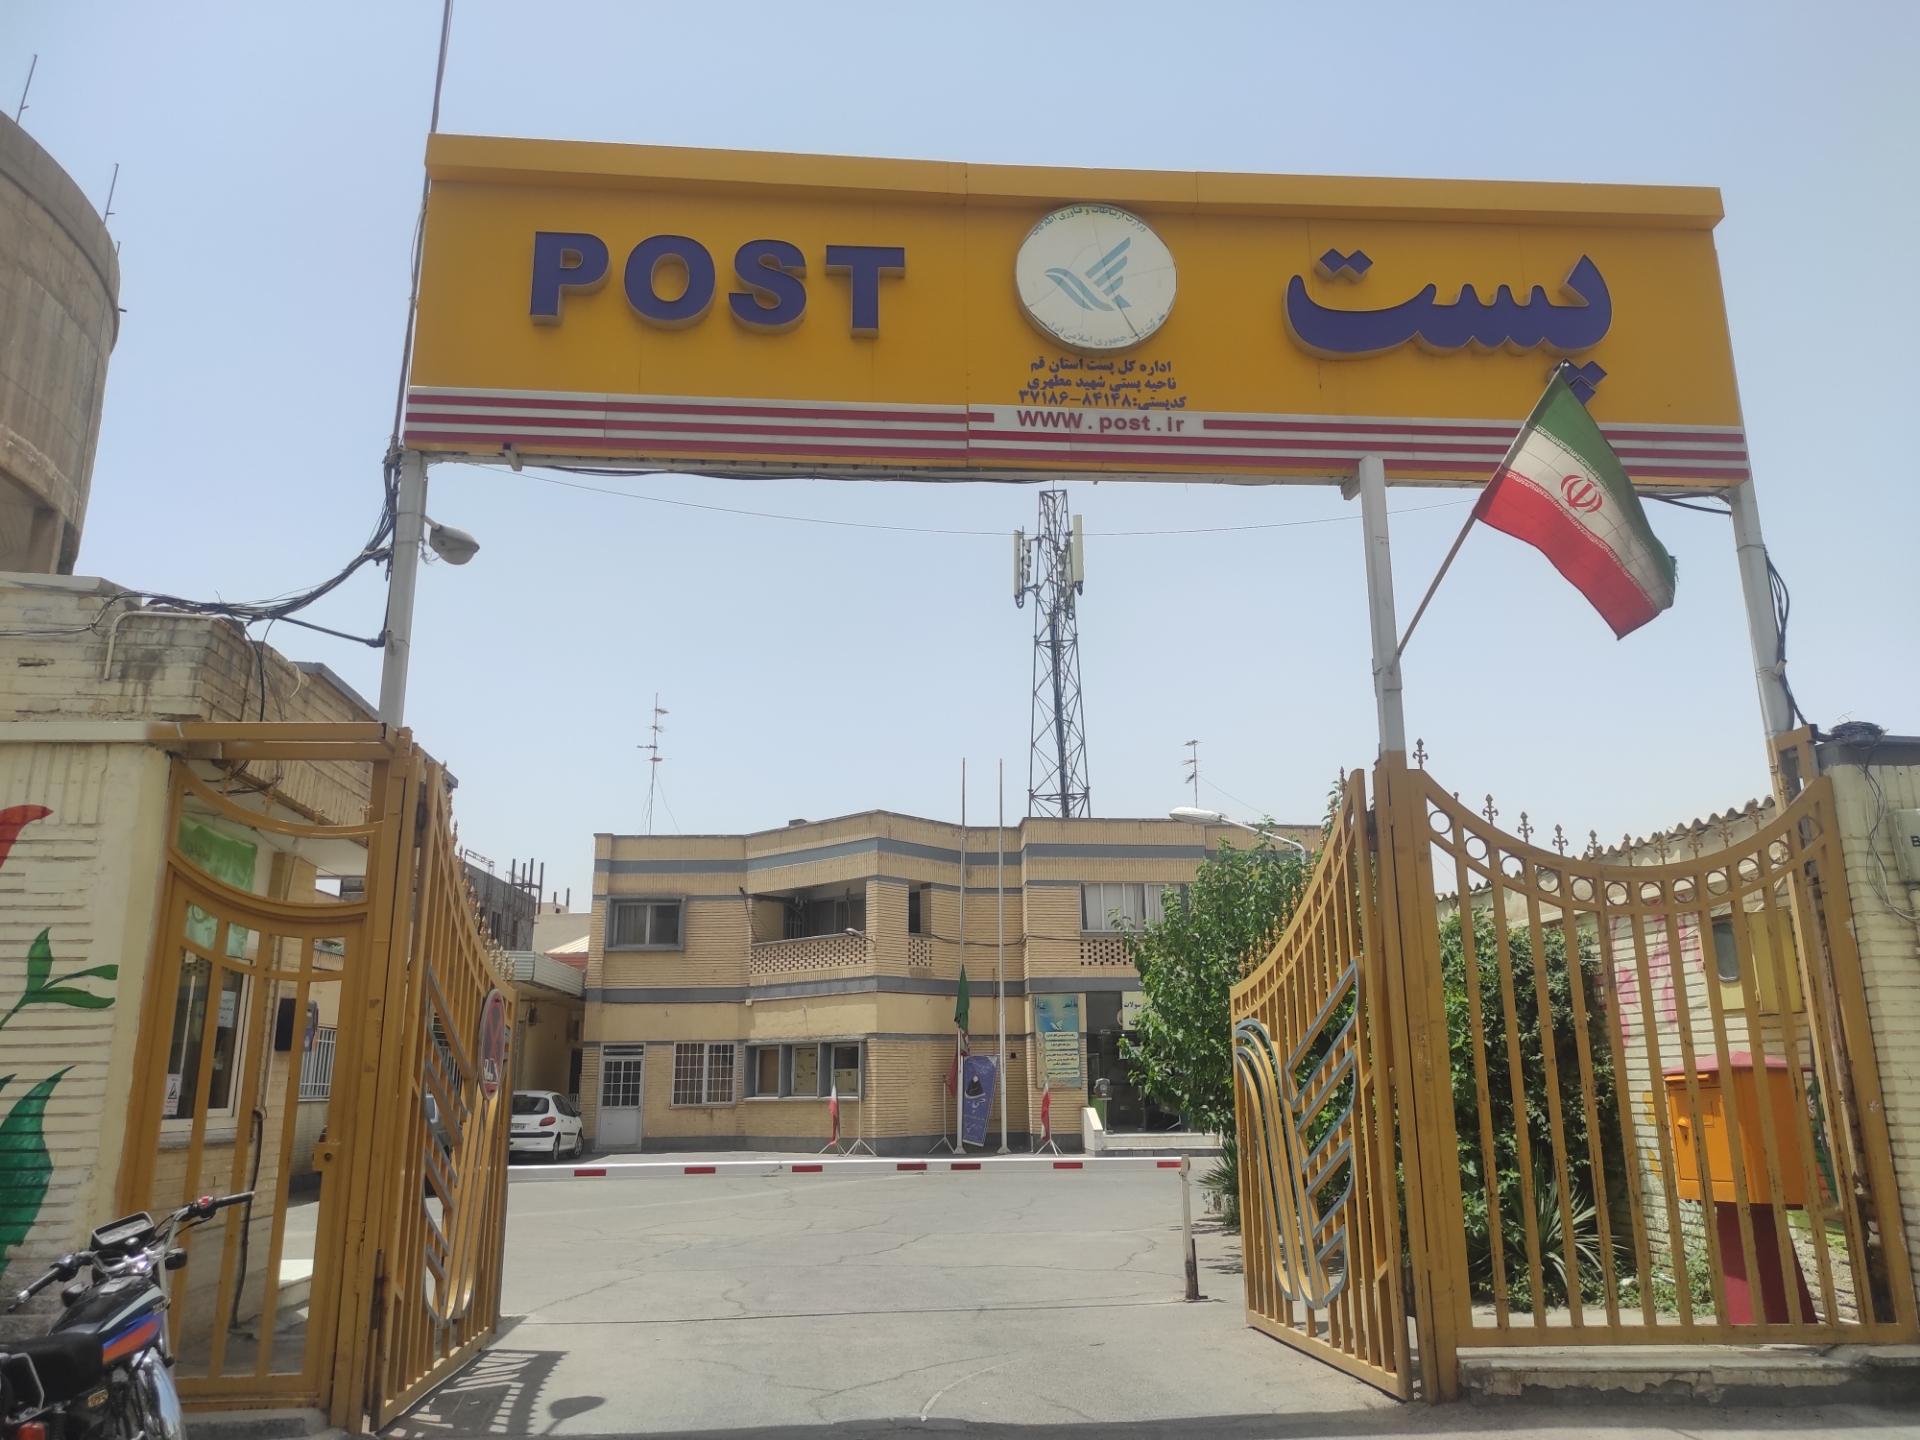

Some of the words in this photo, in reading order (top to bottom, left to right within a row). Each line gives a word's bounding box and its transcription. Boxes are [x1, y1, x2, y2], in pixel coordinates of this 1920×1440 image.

[529, 230, 906, 337] POST
[1283, 248, 1614, 404] پست
[1030, 356, 1046, 373] قم
[1049, 357, 1083, 373] استان
[1087, 360, 1114, 375] پست
[1118, 359, 1136, 375] کل
[1139, 360, 1172, 376] اداره
[1027, 374, 1072, 390] مطهری
[1075, 375, 1106, 390] شهید
[1109, 378, 1141, 393] پستی
[1144, 377, 1177, 392] ناحیه
